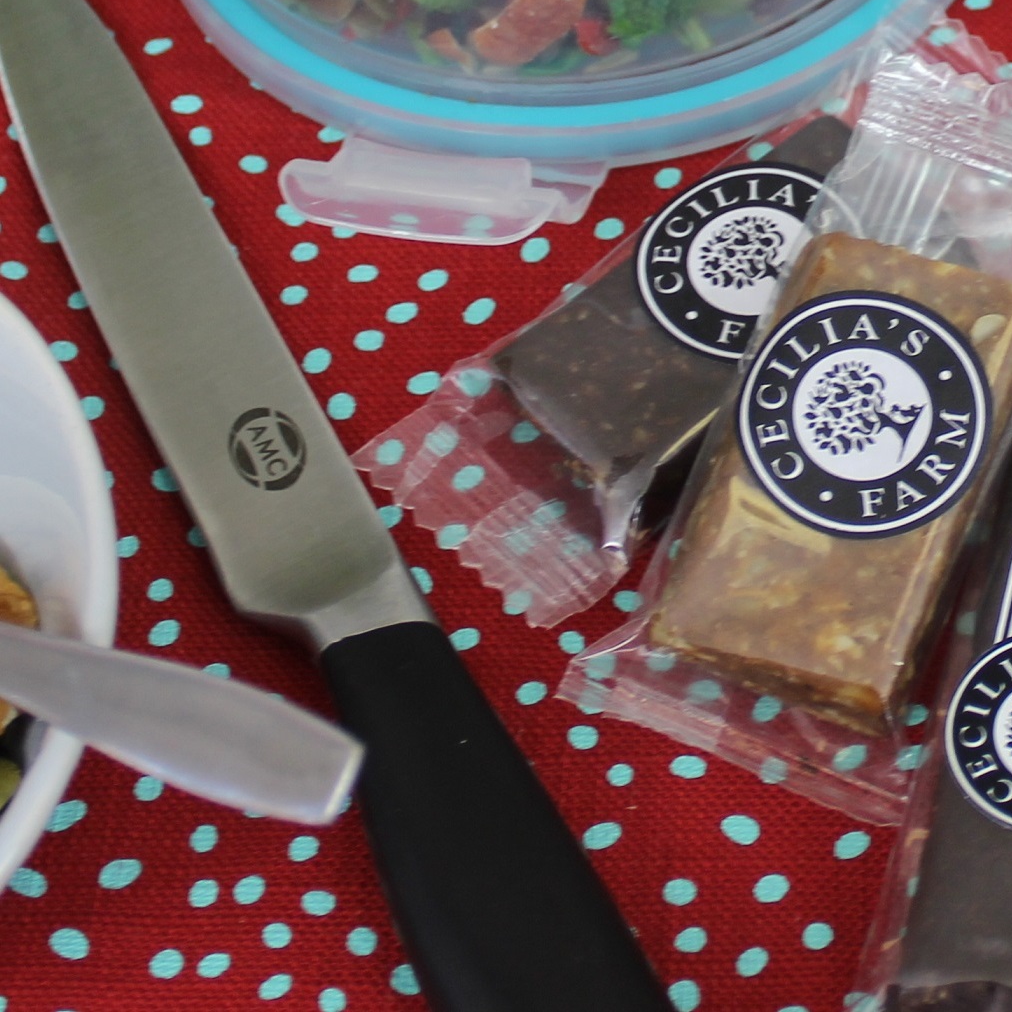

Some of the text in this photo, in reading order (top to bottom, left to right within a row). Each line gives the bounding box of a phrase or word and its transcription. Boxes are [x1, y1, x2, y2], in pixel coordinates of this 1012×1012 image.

[651, 178, 834, 295] CECILIA'S
[245, 425, 289, 477] AMC
[756, 314, 931, 480] CECILIA'S
[857, 409, 970, 518] FARM
